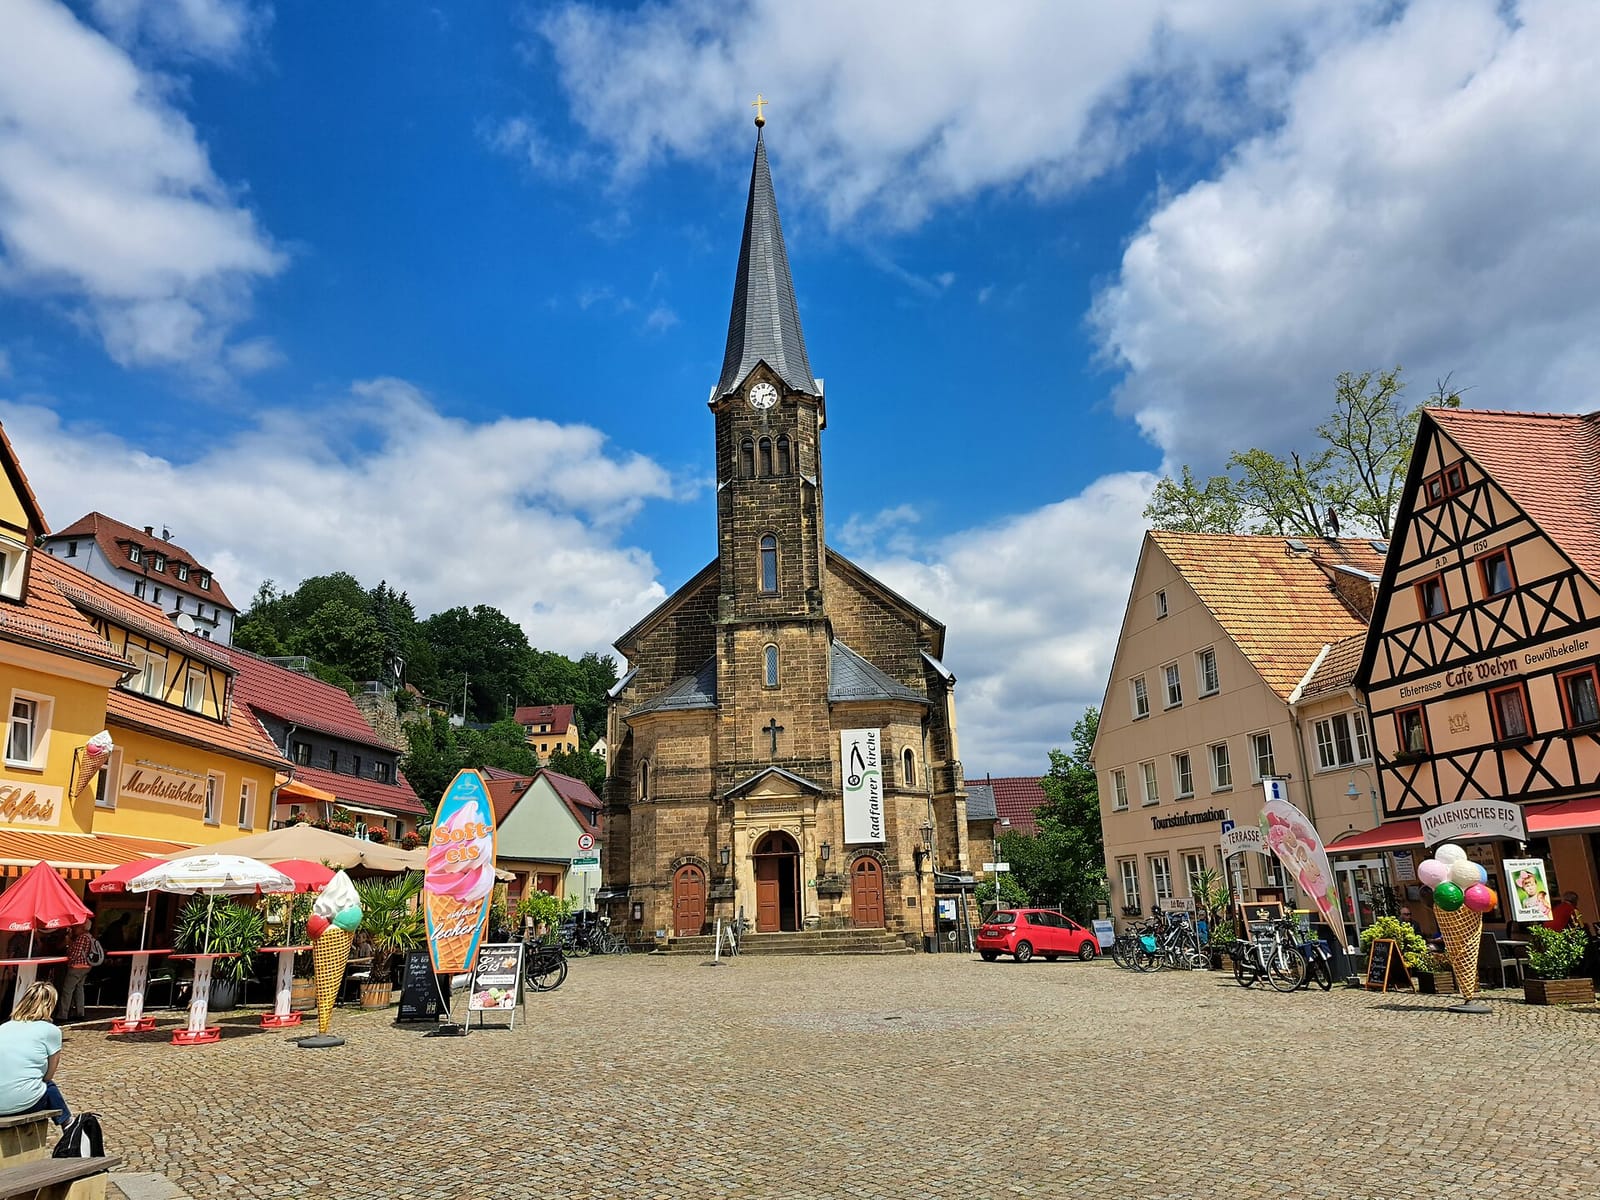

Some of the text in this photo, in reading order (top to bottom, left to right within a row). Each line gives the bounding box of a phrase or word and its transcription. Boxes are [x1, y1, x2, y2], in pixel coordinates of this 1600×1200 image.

[1473, 539, 1488, 553] 1750
[1399, 680, 1442, 699] Elbterrasse
[1524, 639, 1590, 666] Gewölbekeller
[121, 769, 204, 805] Marktstübchen
[865, 731, 881, 839] Radfahrer kirche
[1150, 806, 1226, 831] Touristinformation
[1424, 807, 1515, 831] ITALIENISCHES EIS
[434, 822, 494, 845] Soft-
[1228, 829, 1260, 846] TERRASSE
[445, 843, 480, 864] eis
[430, 916, 486, 941] lecker!
[477, 956, 501, 972] Eis
